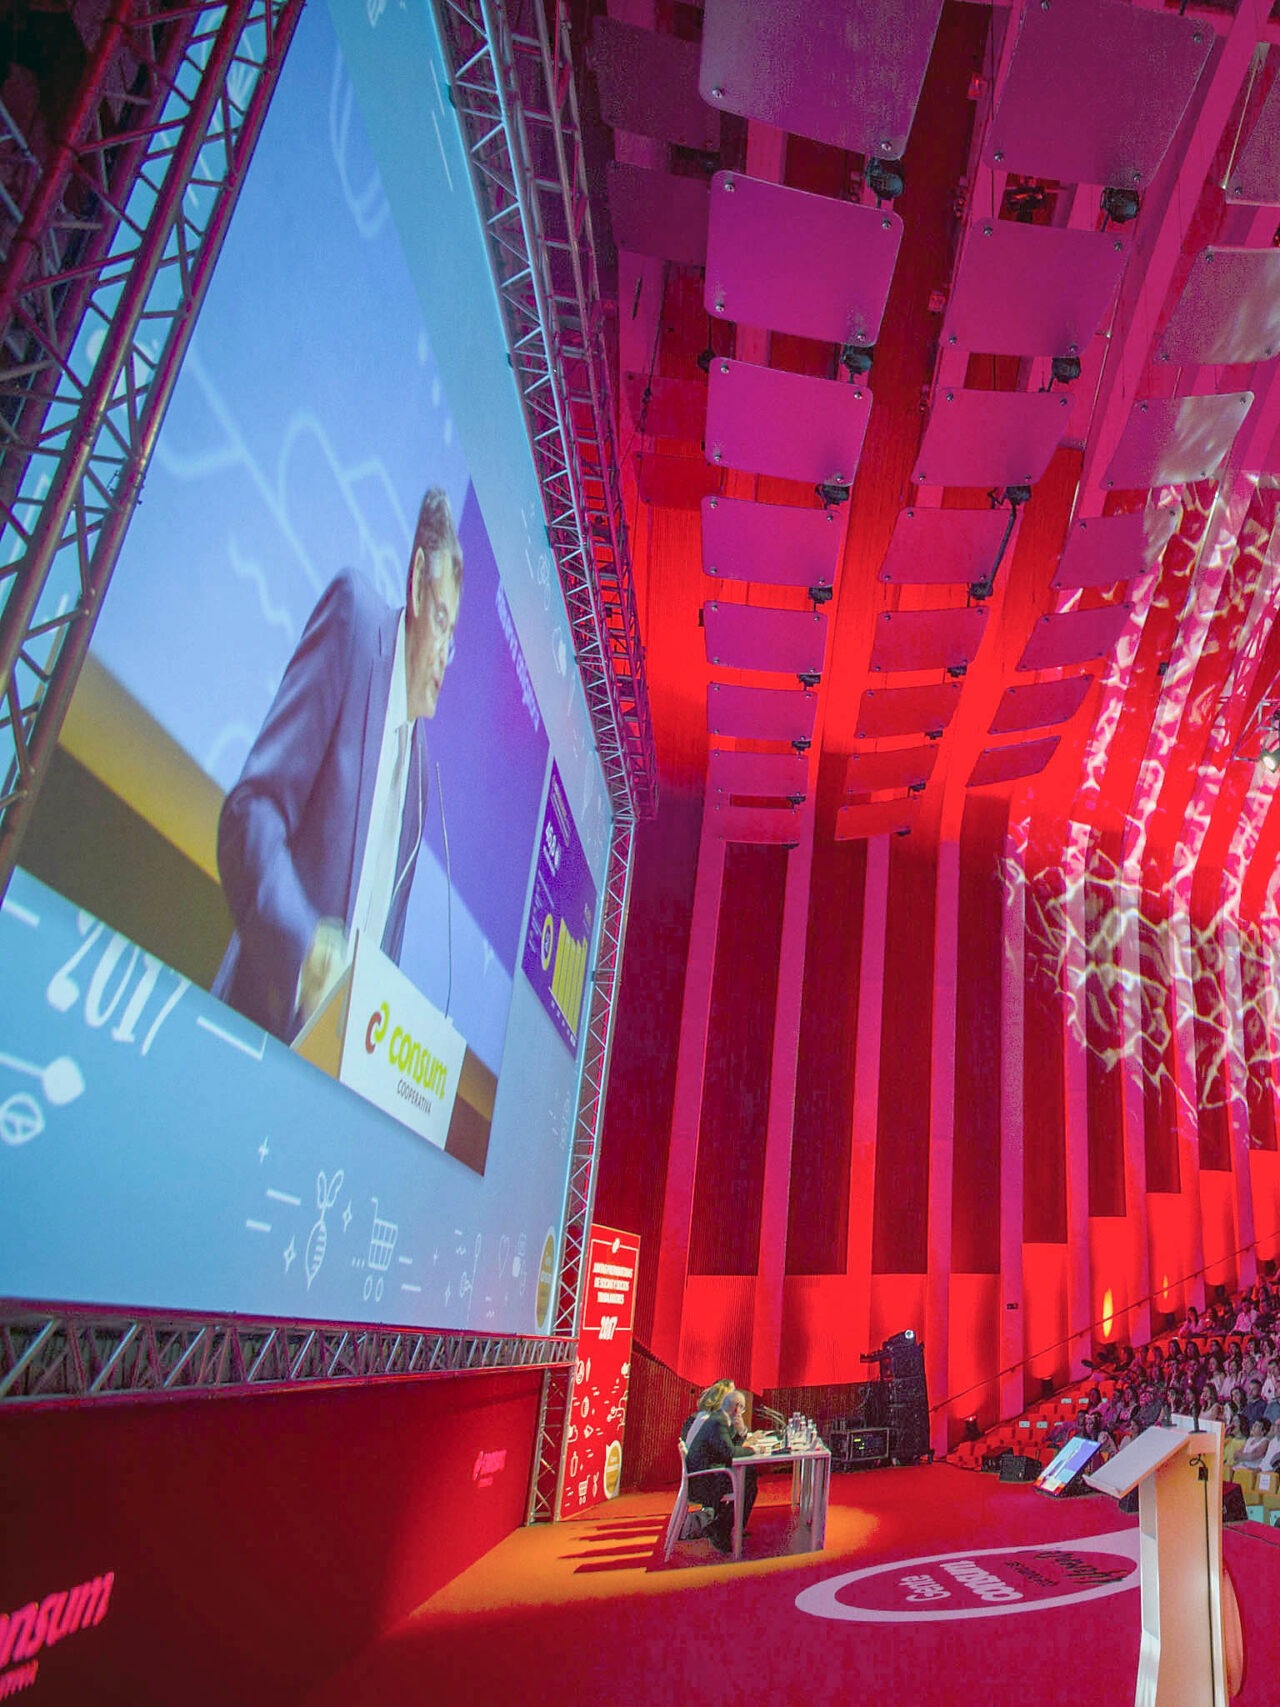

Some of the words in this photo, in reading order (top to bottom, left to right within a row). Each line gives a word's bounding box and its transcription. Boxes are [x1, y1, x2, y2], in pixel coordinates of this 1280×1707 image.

[388, 1024, 447, 1100] consum
[396, 1079, 432, 1115] COOPERATIVA
[898, 1574, 951, 1602] Gente
[939, 1560, 1024, 1601] consum
